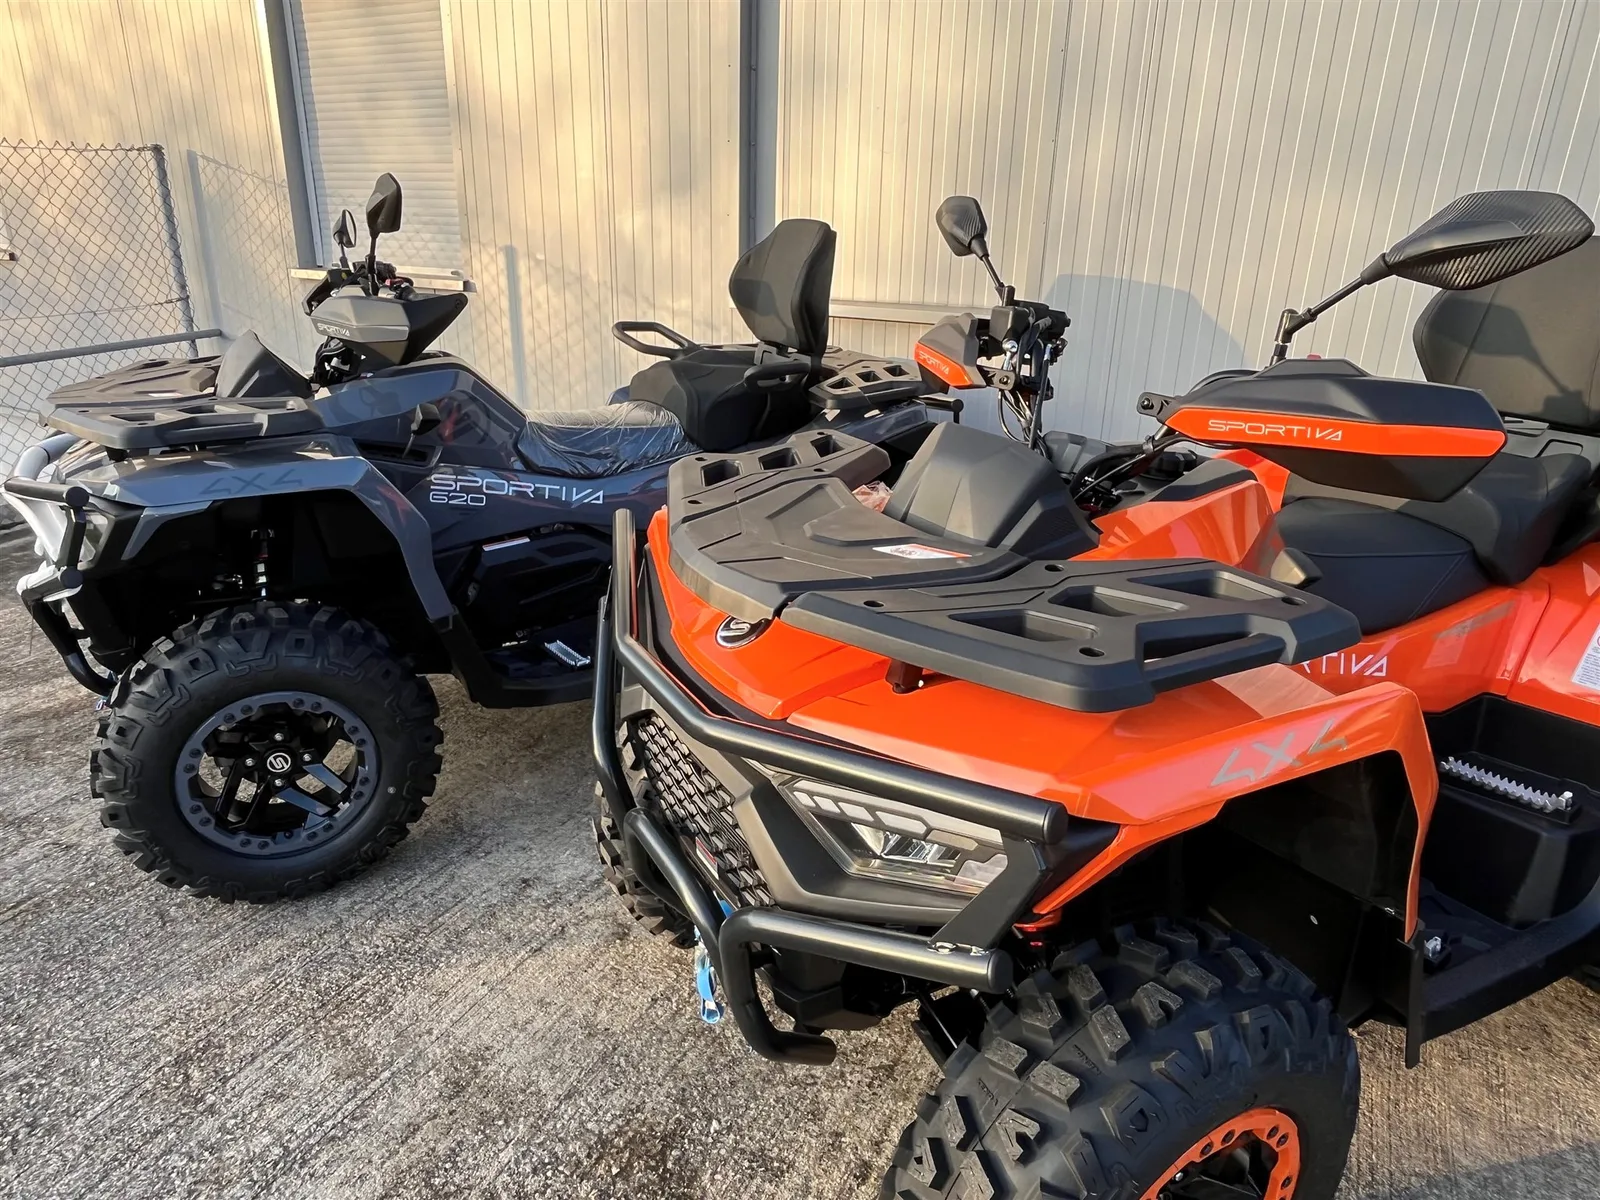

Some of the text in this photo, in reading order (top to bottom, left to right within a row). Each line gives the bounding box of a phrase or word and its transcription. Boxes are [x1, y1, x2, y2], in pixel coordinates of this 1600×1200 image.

[1207, 419, 1343, 441] SPORTIVA
[429, 491, 486, 506] 620
[430, 473, 604, 505] SPORTIVA
